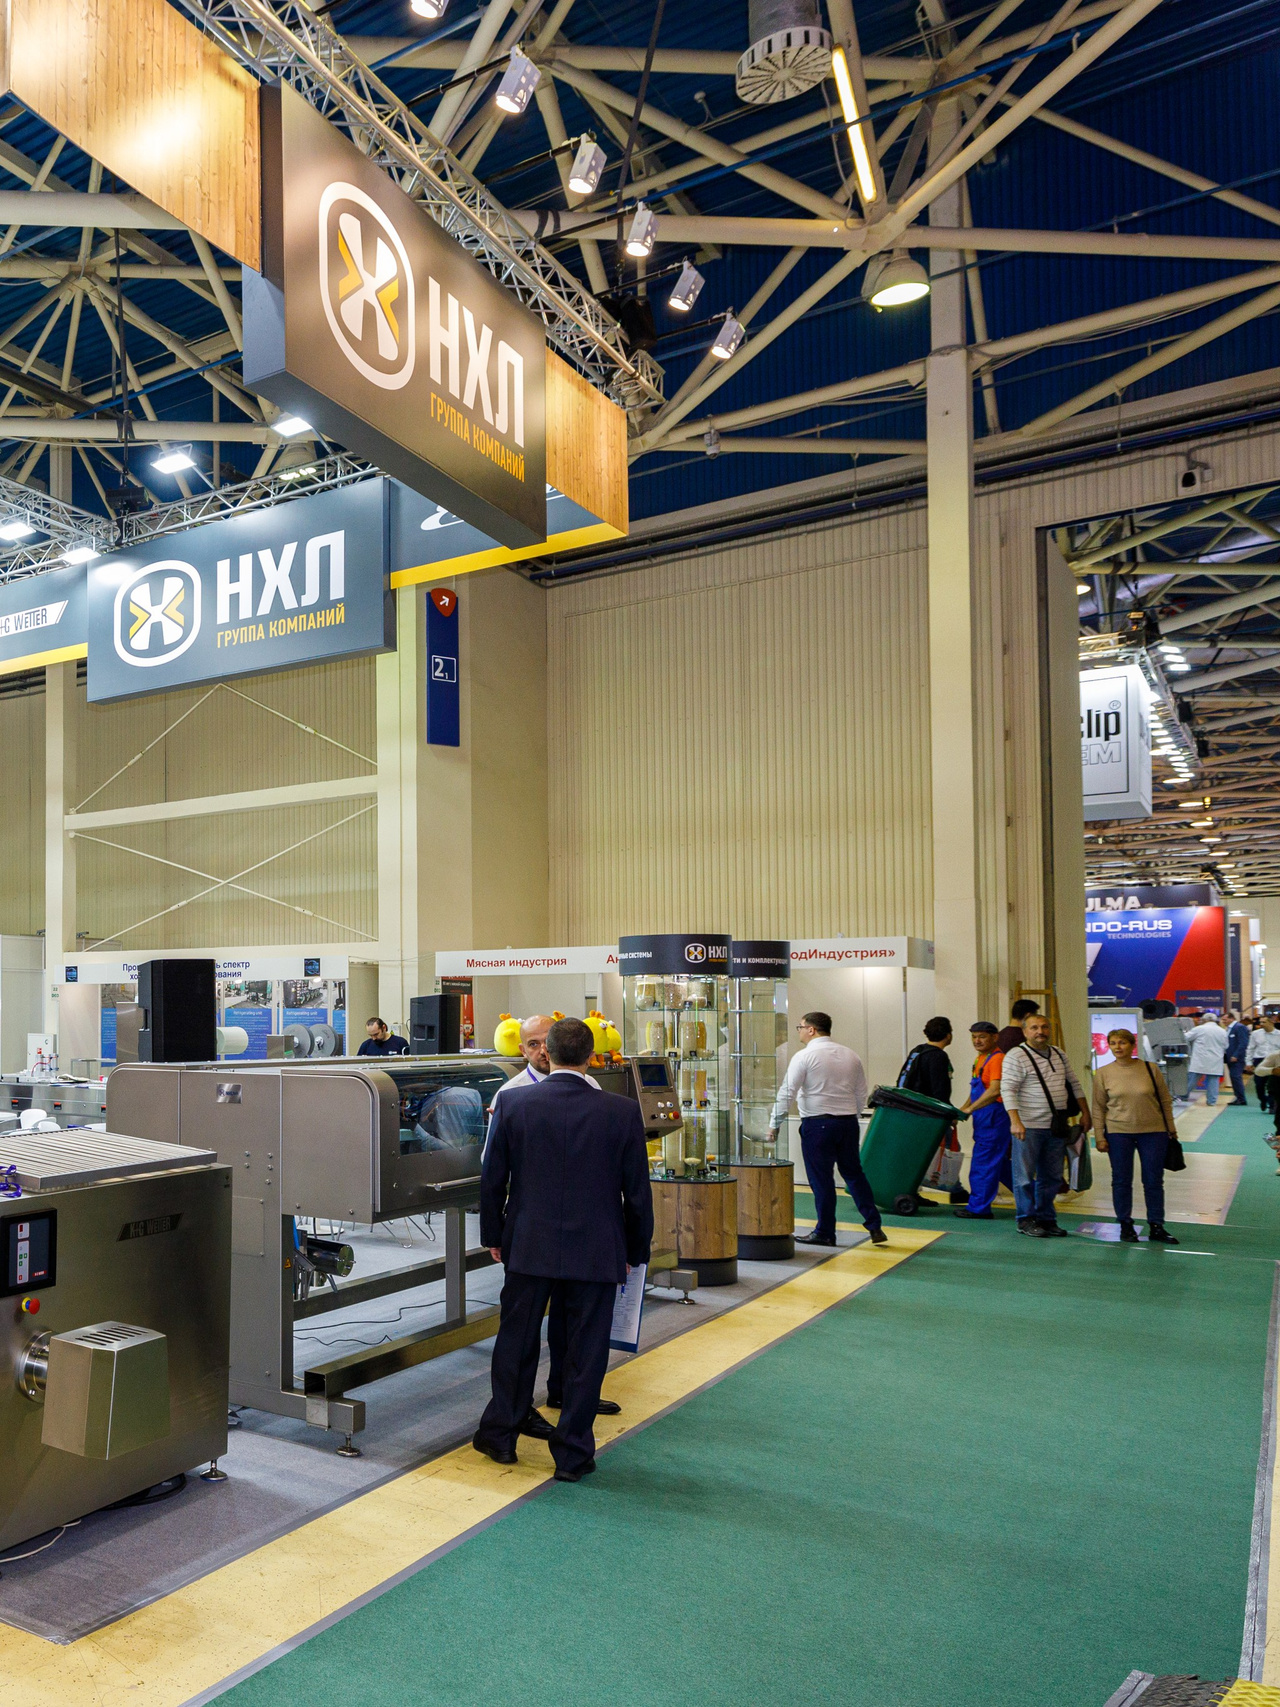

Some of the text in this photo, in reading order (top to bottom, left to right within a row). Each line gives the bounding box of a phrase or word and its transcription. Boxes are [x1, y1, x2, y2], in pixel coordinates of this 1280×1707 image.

[428, 275, 524, 449] НХЛ
[430, 391, 525, 482] ГРУППА КОМПАНИЙ
[216, 530, 345, 625] НХЛ
[217, 603, 345, 648] ГРУППА КОМПАНИЙ
[1080, 709, 1121, 742] lip
[1107, 931, 1172, 940] TECHNOLOGIES
[222, 961, 250, 970] спектр
[466, 957, 567, 968] Мясная индустрия
[628, 951, 652, 959] системы
